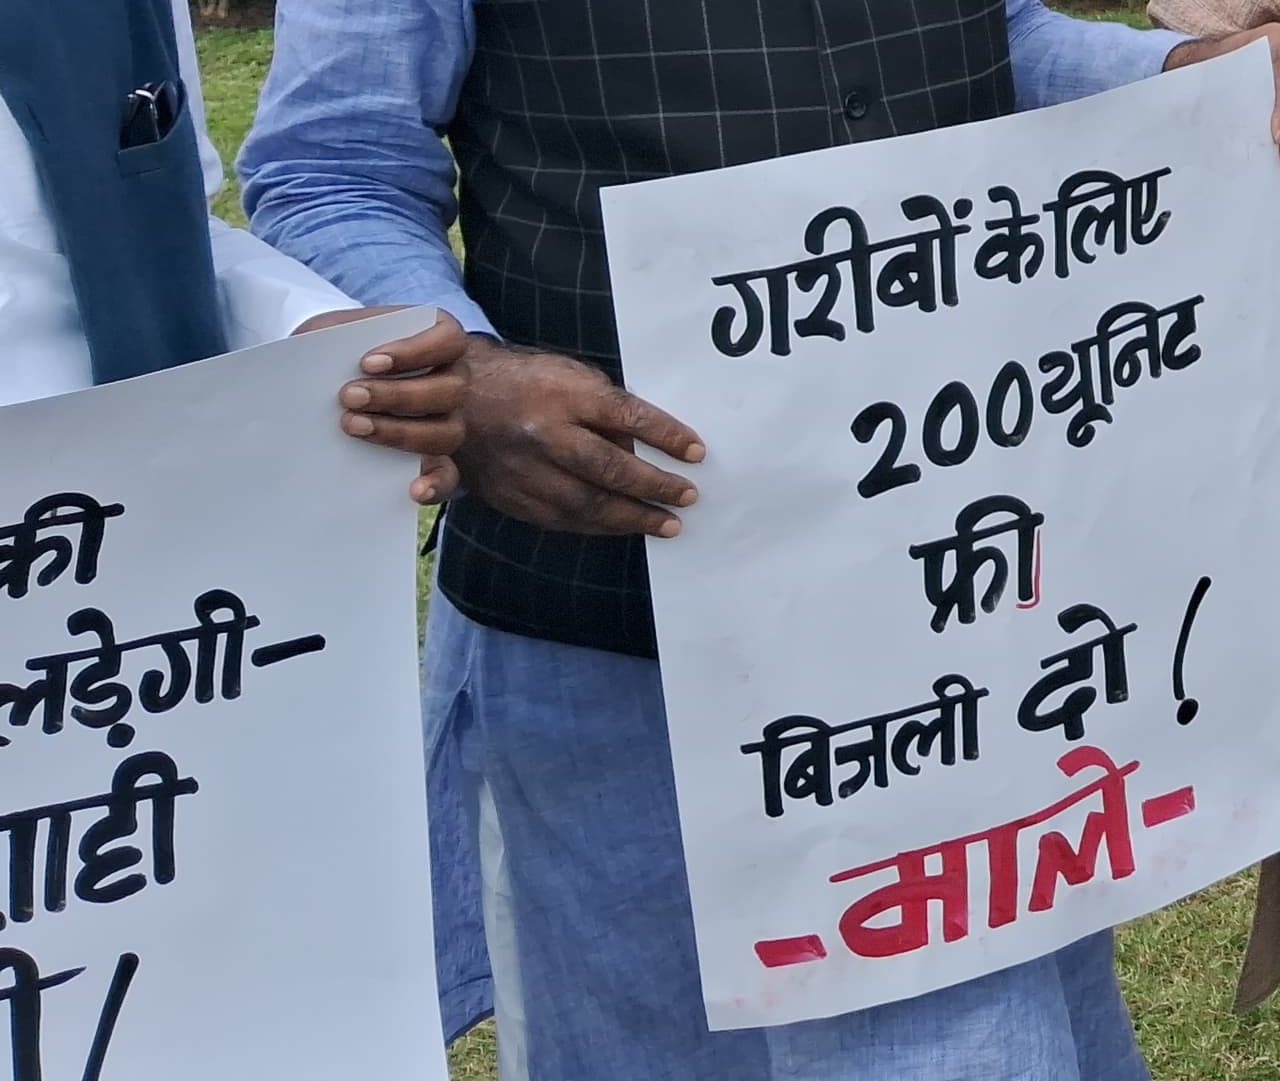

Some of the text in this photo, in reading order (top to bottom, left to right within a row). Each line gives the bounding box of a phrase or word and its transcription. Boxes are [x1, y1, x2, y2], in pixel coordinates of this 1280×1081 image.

[711, 166, 1172, 358] गरीबों के लिए
[908, 495, 1045, 634] फ्री
[740, 674, 990, 818] बिजली
